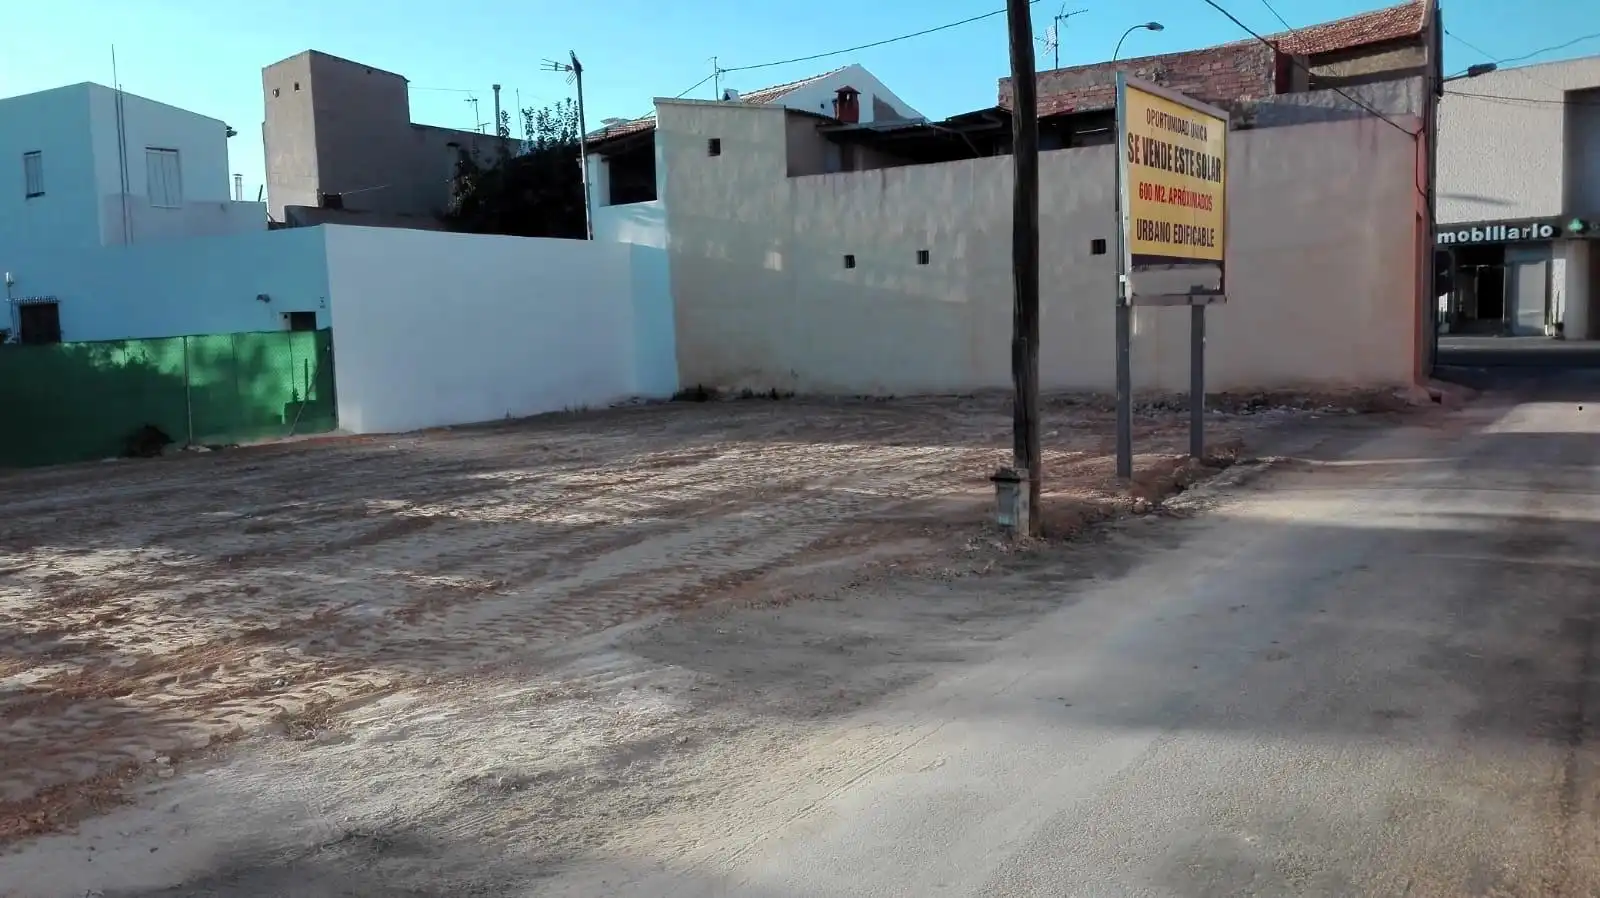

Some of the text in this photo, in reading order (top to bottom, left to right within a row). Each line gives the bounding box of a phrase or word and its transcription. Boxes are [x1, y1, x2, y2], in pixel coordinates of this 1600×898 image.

[1146, 107, 1208, 142] OPORTUNIDAD ÚNICA
[1127, 132, 1221, 183] SE VENDE ESTE SOLAR
[1139, 181, 1153, 201] 600
[1136, 218, 1215, 248] URBANO EDIFICABLE
